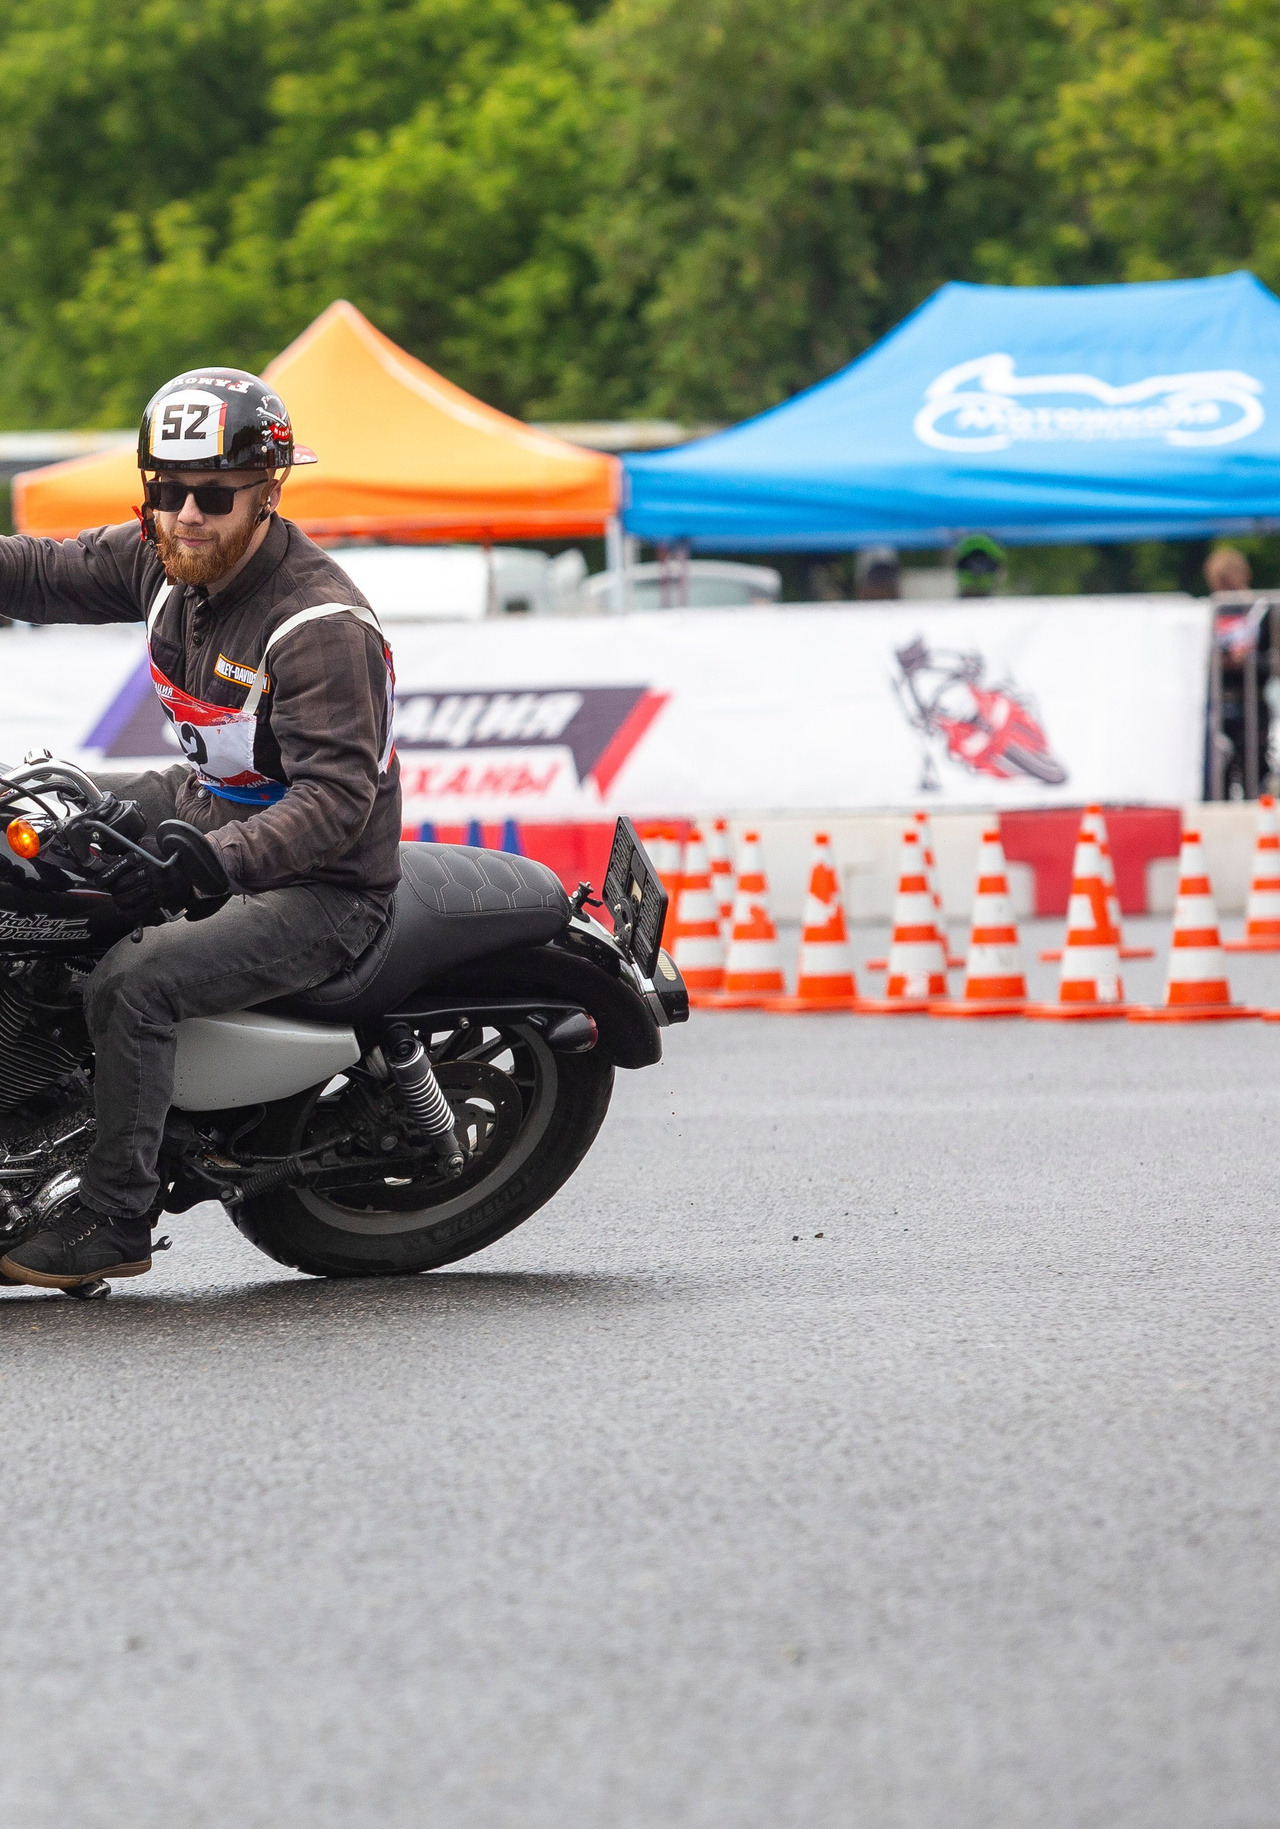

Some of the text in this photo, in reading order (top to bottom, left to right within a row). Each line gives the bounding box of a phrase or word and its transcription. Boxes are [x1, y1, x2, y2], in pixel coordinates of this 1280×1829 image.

[161, 404, 210, 440] 52
[394, 692, 583, 746] АЦИЯ
[401, 760, 560, 796] ХАНЫ
